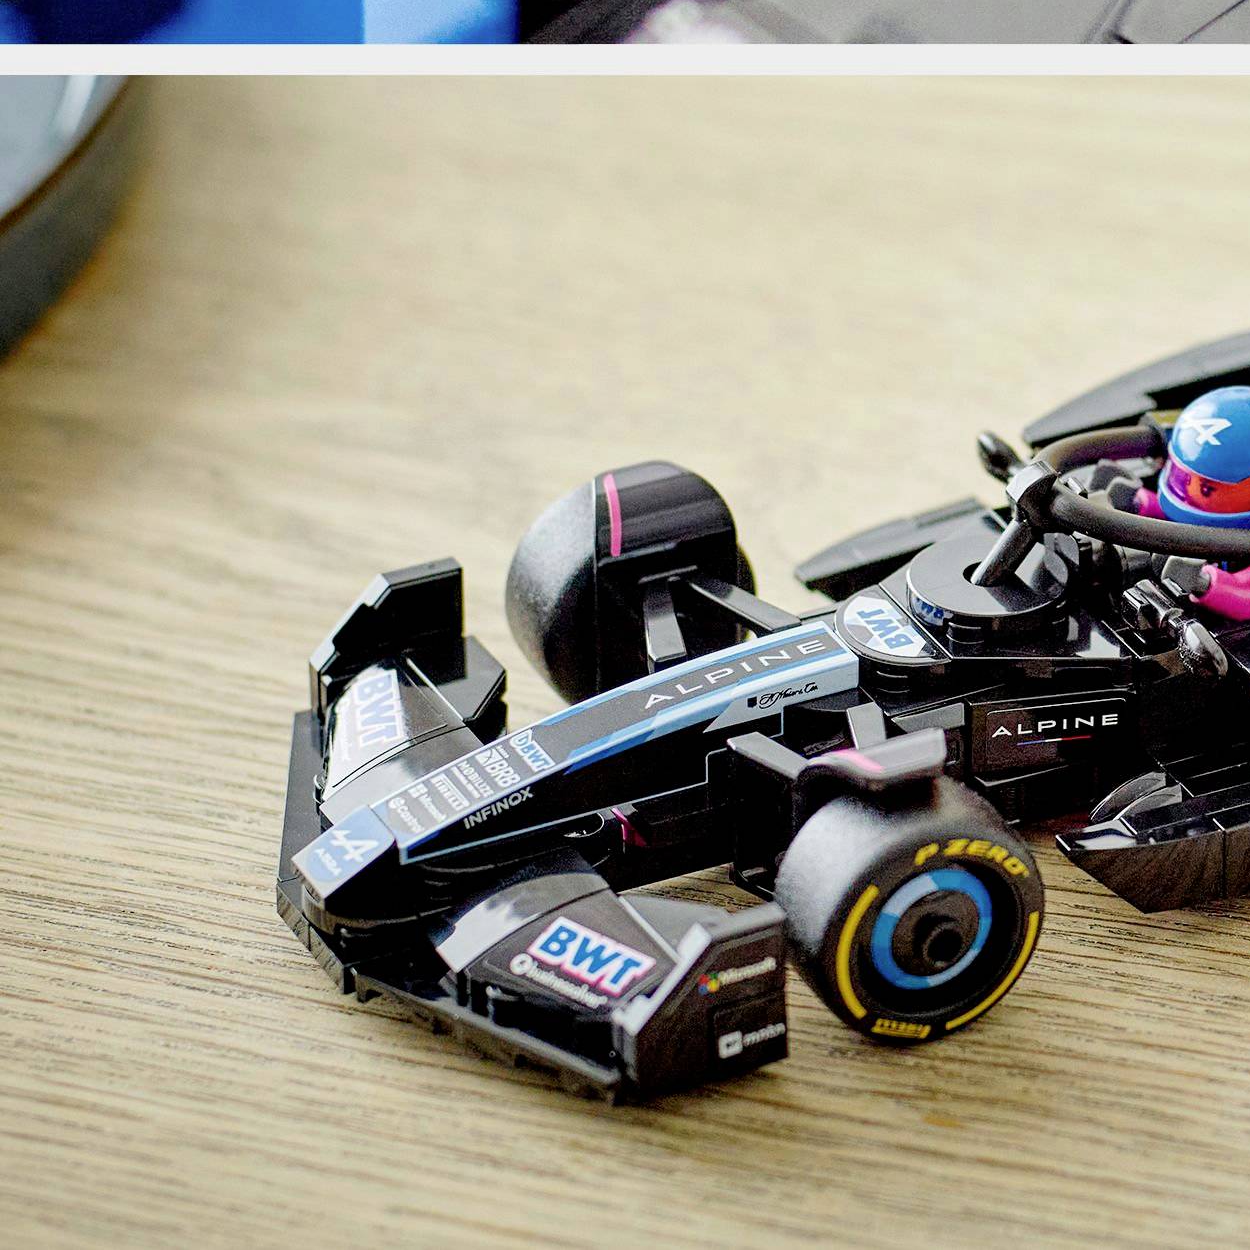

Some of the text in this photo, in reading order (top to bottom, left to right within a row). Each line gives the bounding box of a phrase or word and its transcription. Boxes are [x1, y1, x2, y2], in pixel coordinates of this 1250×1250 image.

[856, 608, 915, 650] BWT
[644, 639, 827, 711] ALPINE
[991, 713, 1119, 739] ALPINE
[463, 786, 534, 829] INFINOX
[539, 924, 643, 986] BWT
